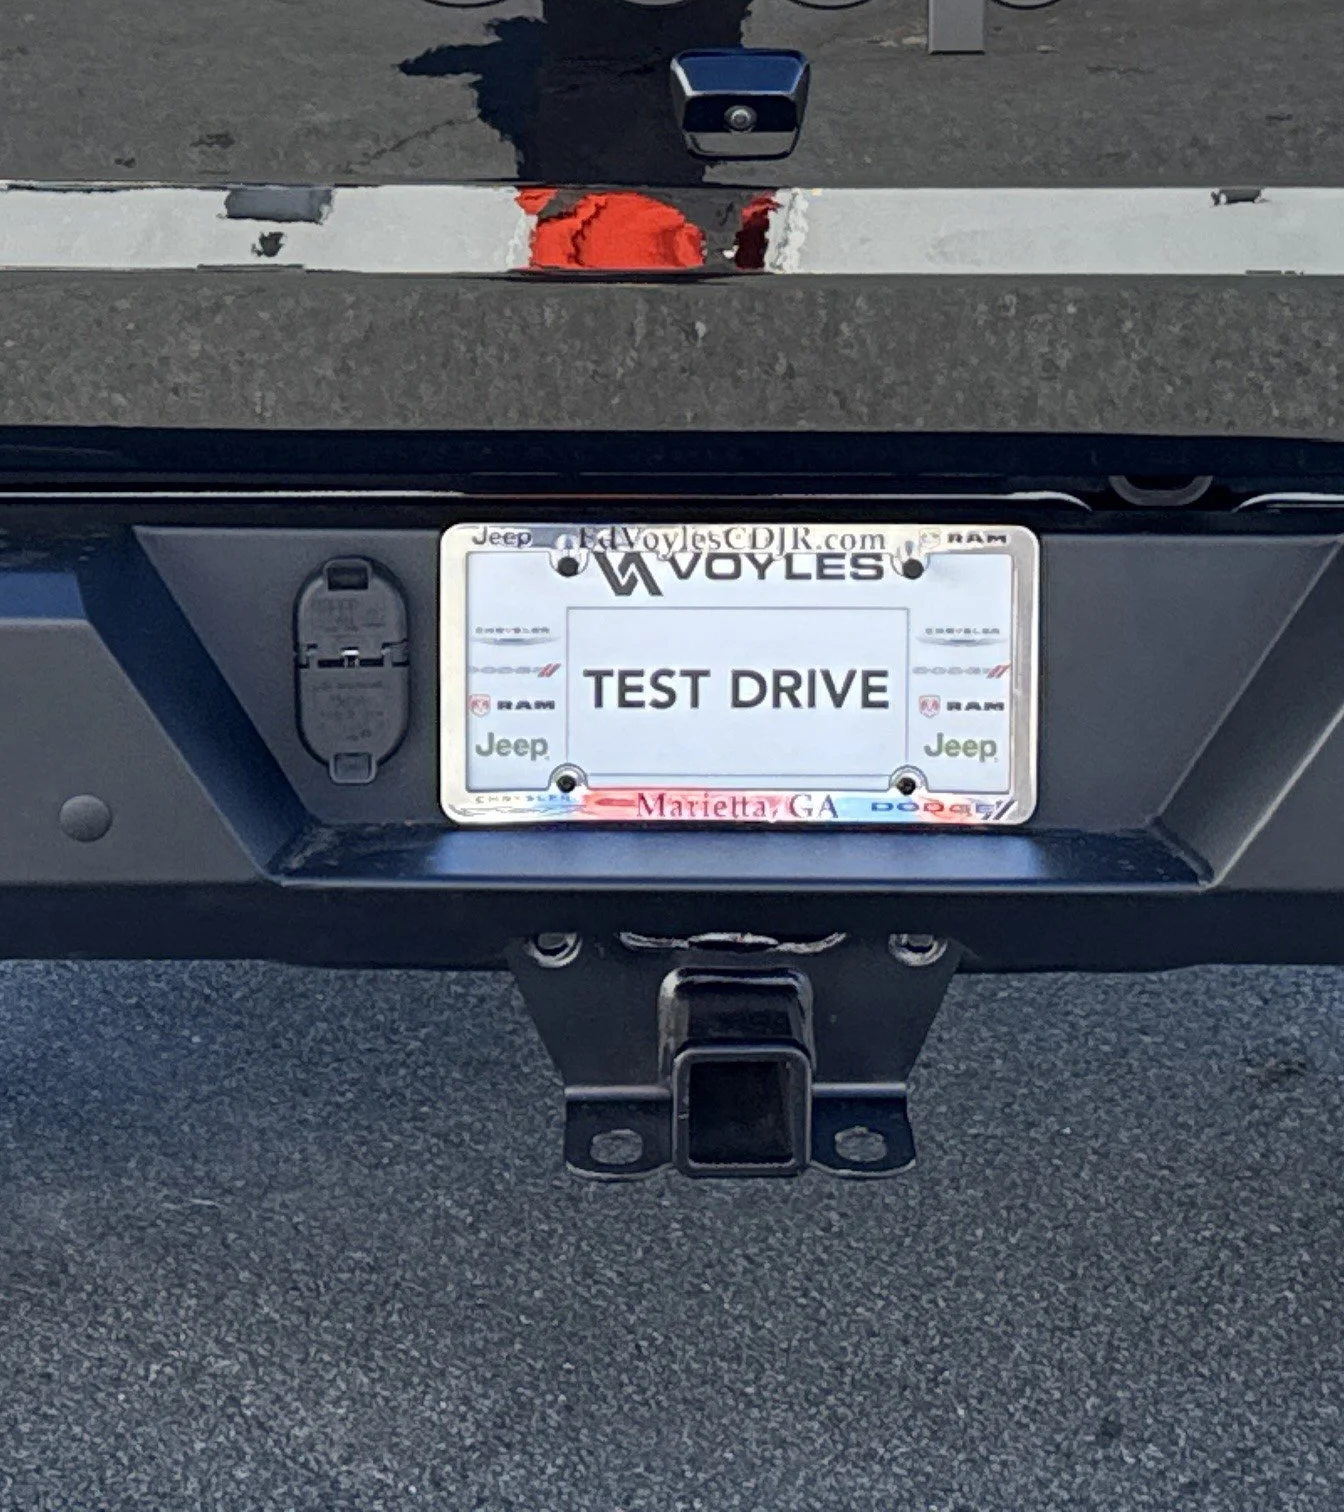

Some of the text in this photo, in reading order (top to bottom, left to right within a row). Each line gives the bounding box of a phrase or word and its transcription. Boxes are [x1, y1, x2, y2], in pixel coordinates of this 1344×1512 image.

[471, 526, 532, 548] Jeep
[947, 533, 1007, 544] RAM
[670, 552, 884, 580] VOYLES
[583, 669, 889, 709] TEST DRIVE
[497, 700, 555, 710] RAM
[946, 701, 1004, 711] RAM
[475, 732, 548, 761] Jeep
[924, 732, 997, 763] Jeep
[637, 793, 838, 819] Marietta, GA
